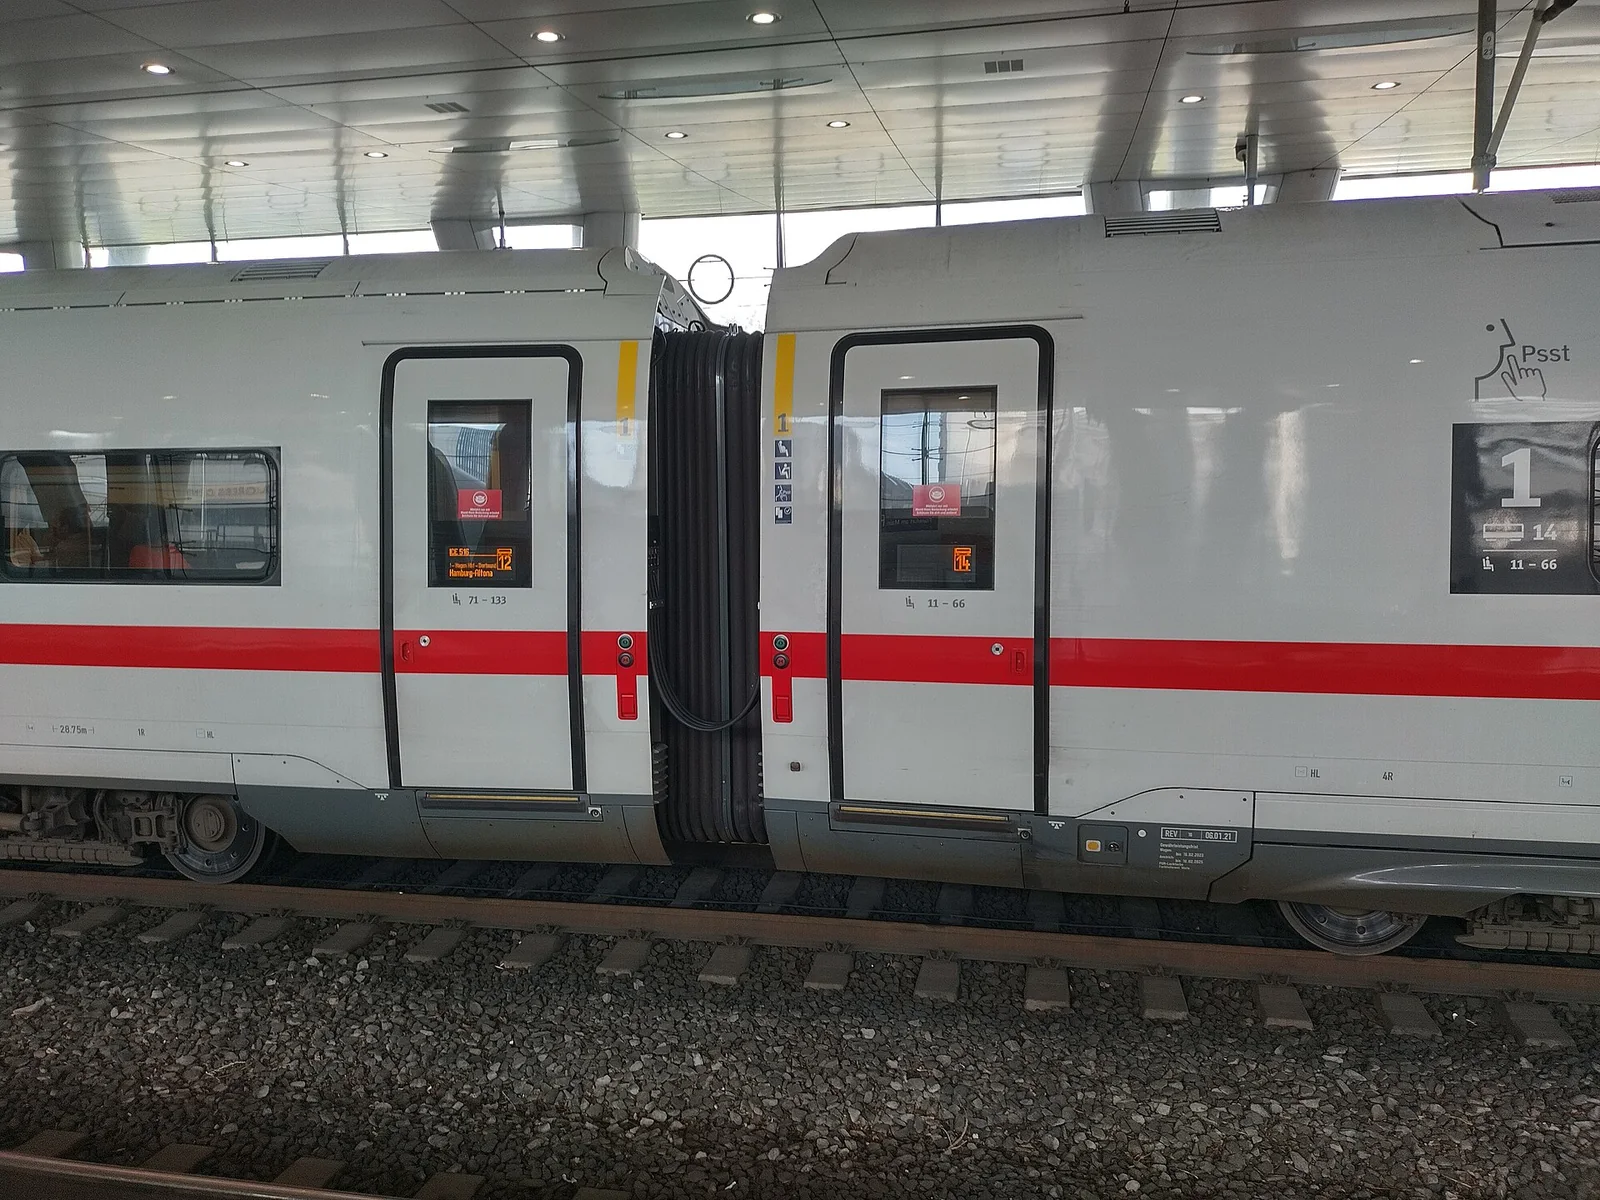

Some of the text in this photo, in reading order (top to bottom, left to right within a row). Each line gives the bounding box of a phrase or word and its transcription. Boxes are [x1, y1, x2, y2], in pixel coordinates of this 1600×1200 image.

[1522, 344, 1570, 362] Psst
[619, 417, 632, 436] 1
[777, 412, 789, 432] 1
[1501, 447, 1541, 508] 1
[1532, 523, 1557, 541] 14
[498, 555, 512, 570] 12
[956, 555, 970, 571] 14
[1510, 559, 1524, 570] 11
[1541, 558, 1557, 570] 66
[449, 569, 494, 578] Hamburg-Altona
[468, 595, 478, 604] 71
[491, 595, 507, 605] 133
[927, 599, 939, 608] 11
[952, 599, 966, 609] 66
[60, 725, 88, 735] 28.75m
[137, 728, 146, 736] 1R
[206, 730, 215, 739] HL
[1310, 768, 1320, 778] HL
[1382, 771, 1394, 781] 4R
[1165, 830, 1178, 838] REV
